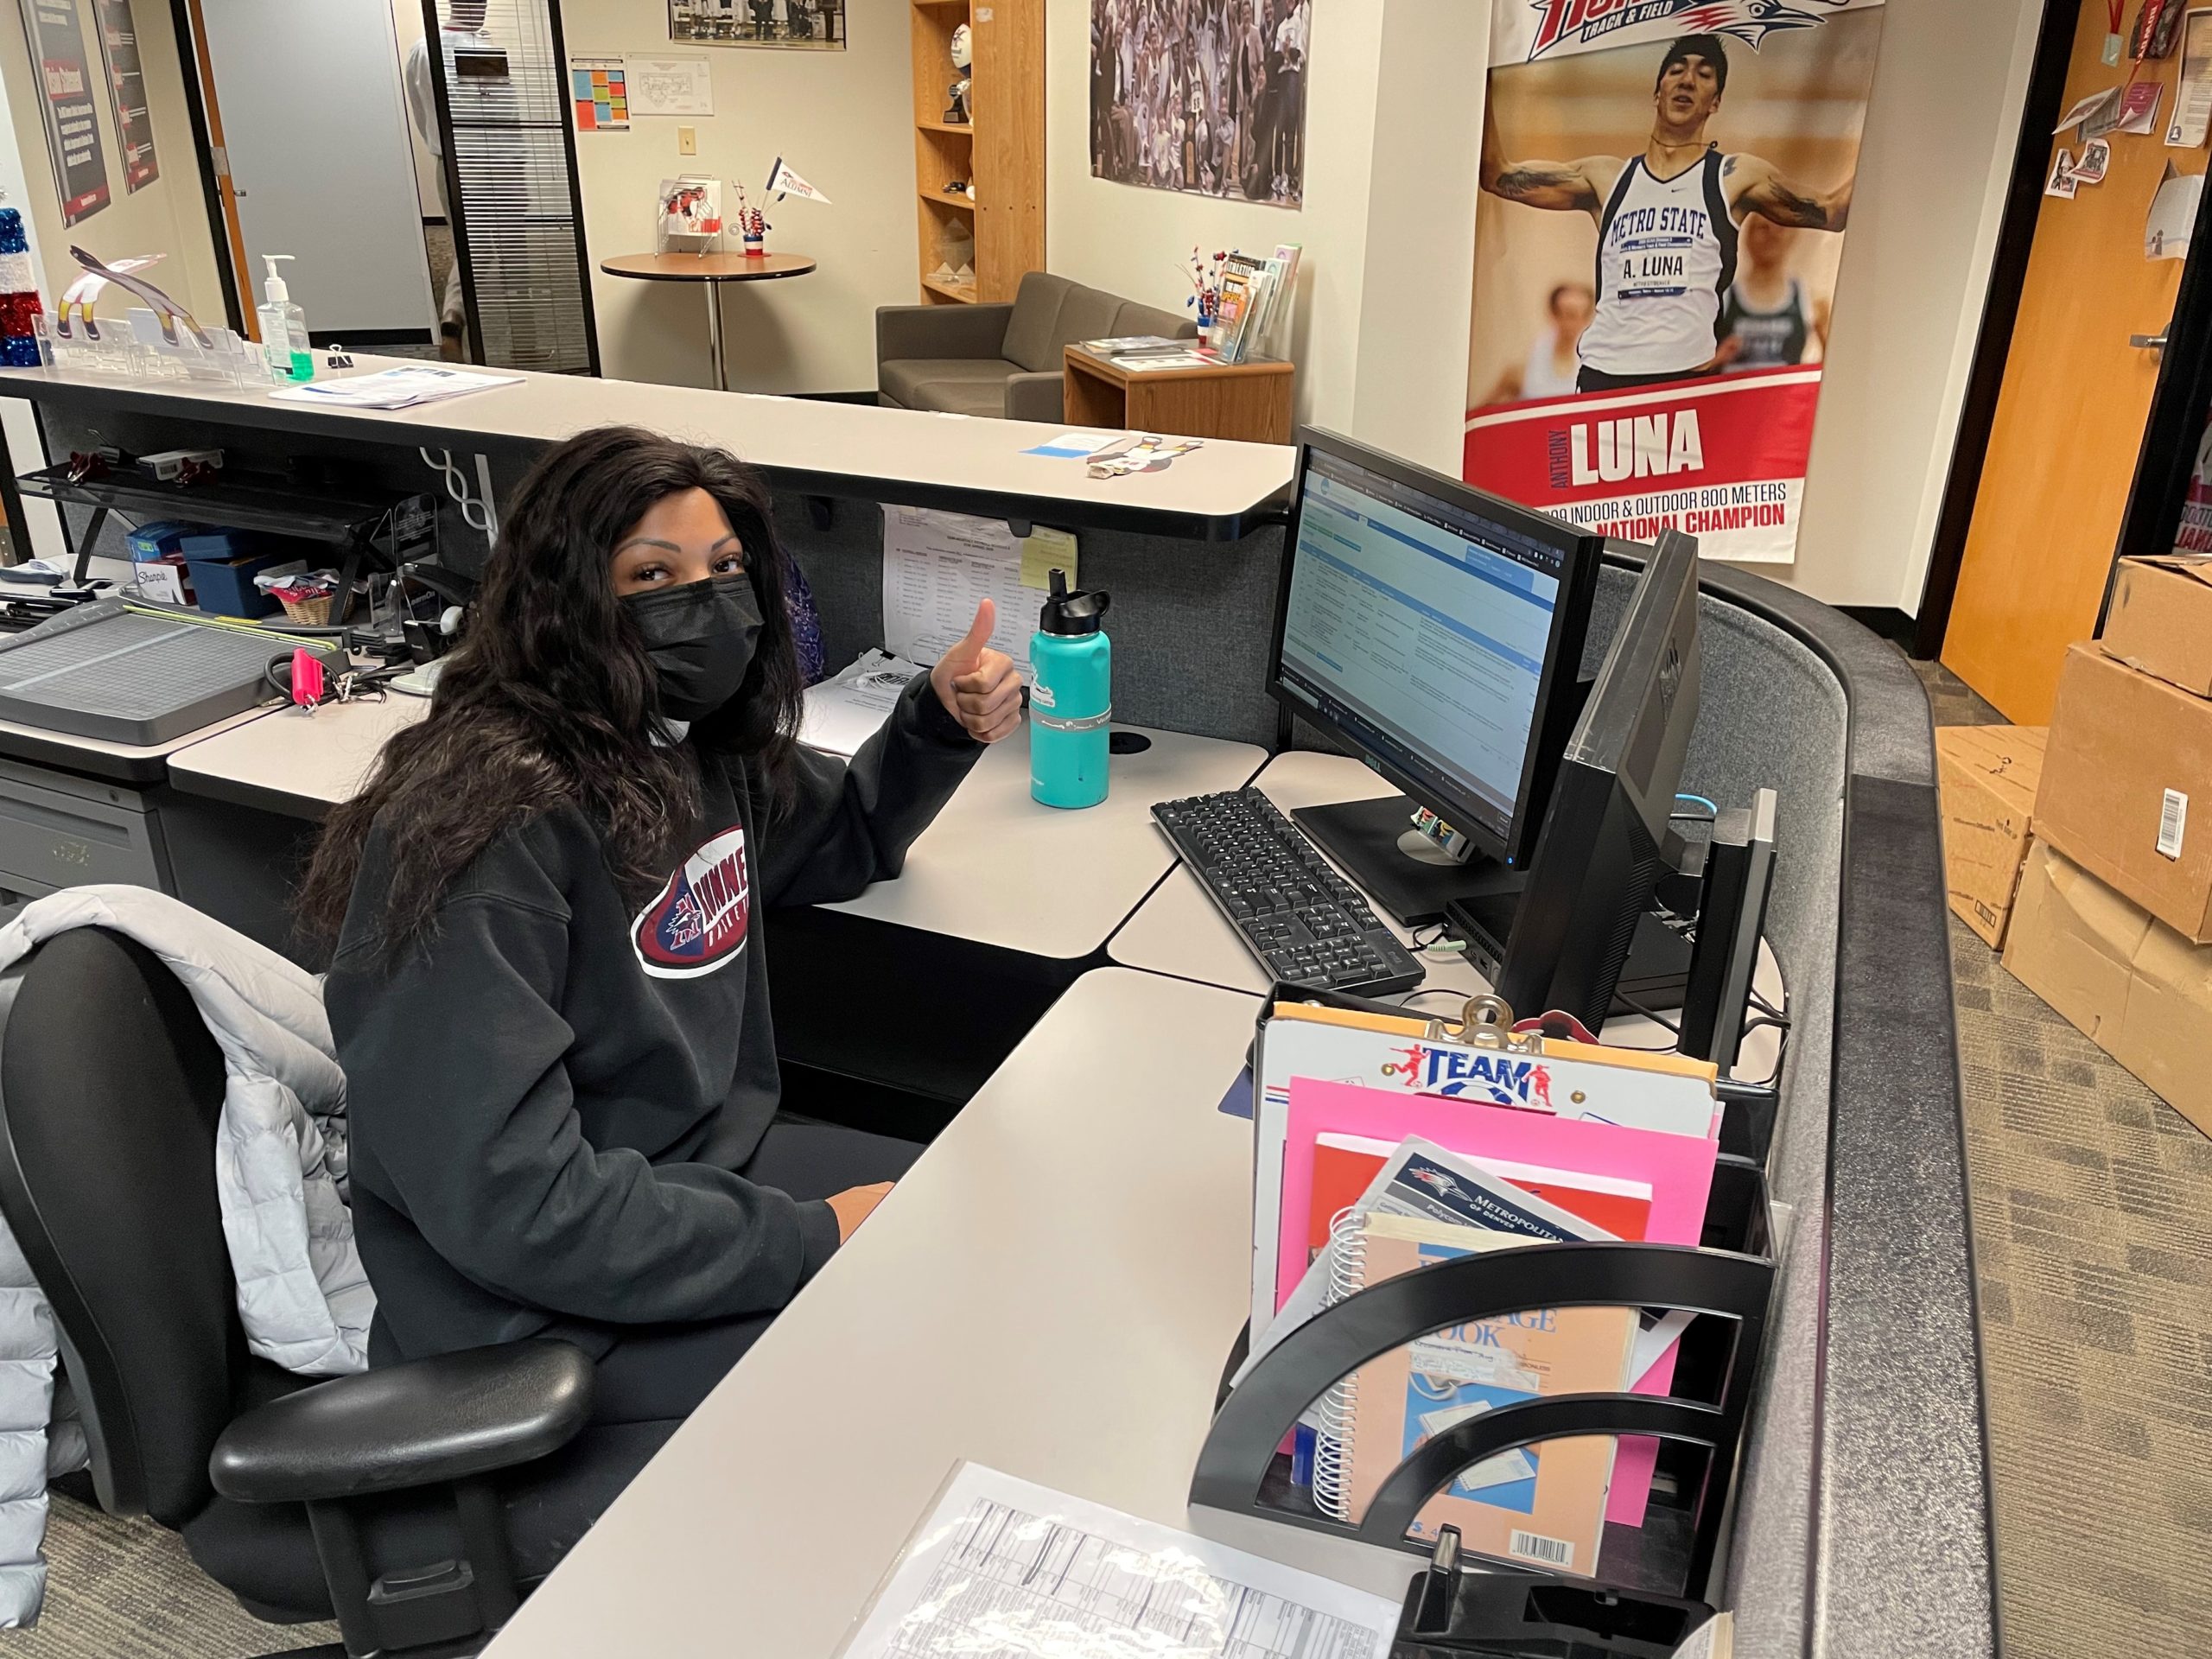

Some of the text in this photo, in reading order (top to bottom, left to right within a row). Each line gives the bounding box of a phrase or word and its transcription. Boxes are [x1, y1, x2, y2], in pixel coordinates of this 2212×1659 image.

[1583, 3, 1673, 41] TRACK & FIELD
[781, 178, 811, 198] ALUMNI
[1611, 207, 1707, 247] METRO STATE
[1624, 256, 1682, 278] A. LUNA
[1548, 430, 1568, 489] ANTHONY
[1571, 409, 1704, 486] LUNA
[1571, 502, 1618, 524] INDOOR
[1623, 500, 1632, 517] &
[1637, 492, 1697, 516] OUTDOOR
[1701, 488, 1728, 507] 800
[1732, 483, 1786, 505] METERS
[1685, 504, 1785, 533] CHAMPION
[138, 571, 168, 584] Sharpie
[1423, 1047, 1532, 1102] TEAM
[1469, 1203, 1515, 1230] OF DENVER
[1437, 1323, 1505, 1348] OOK
